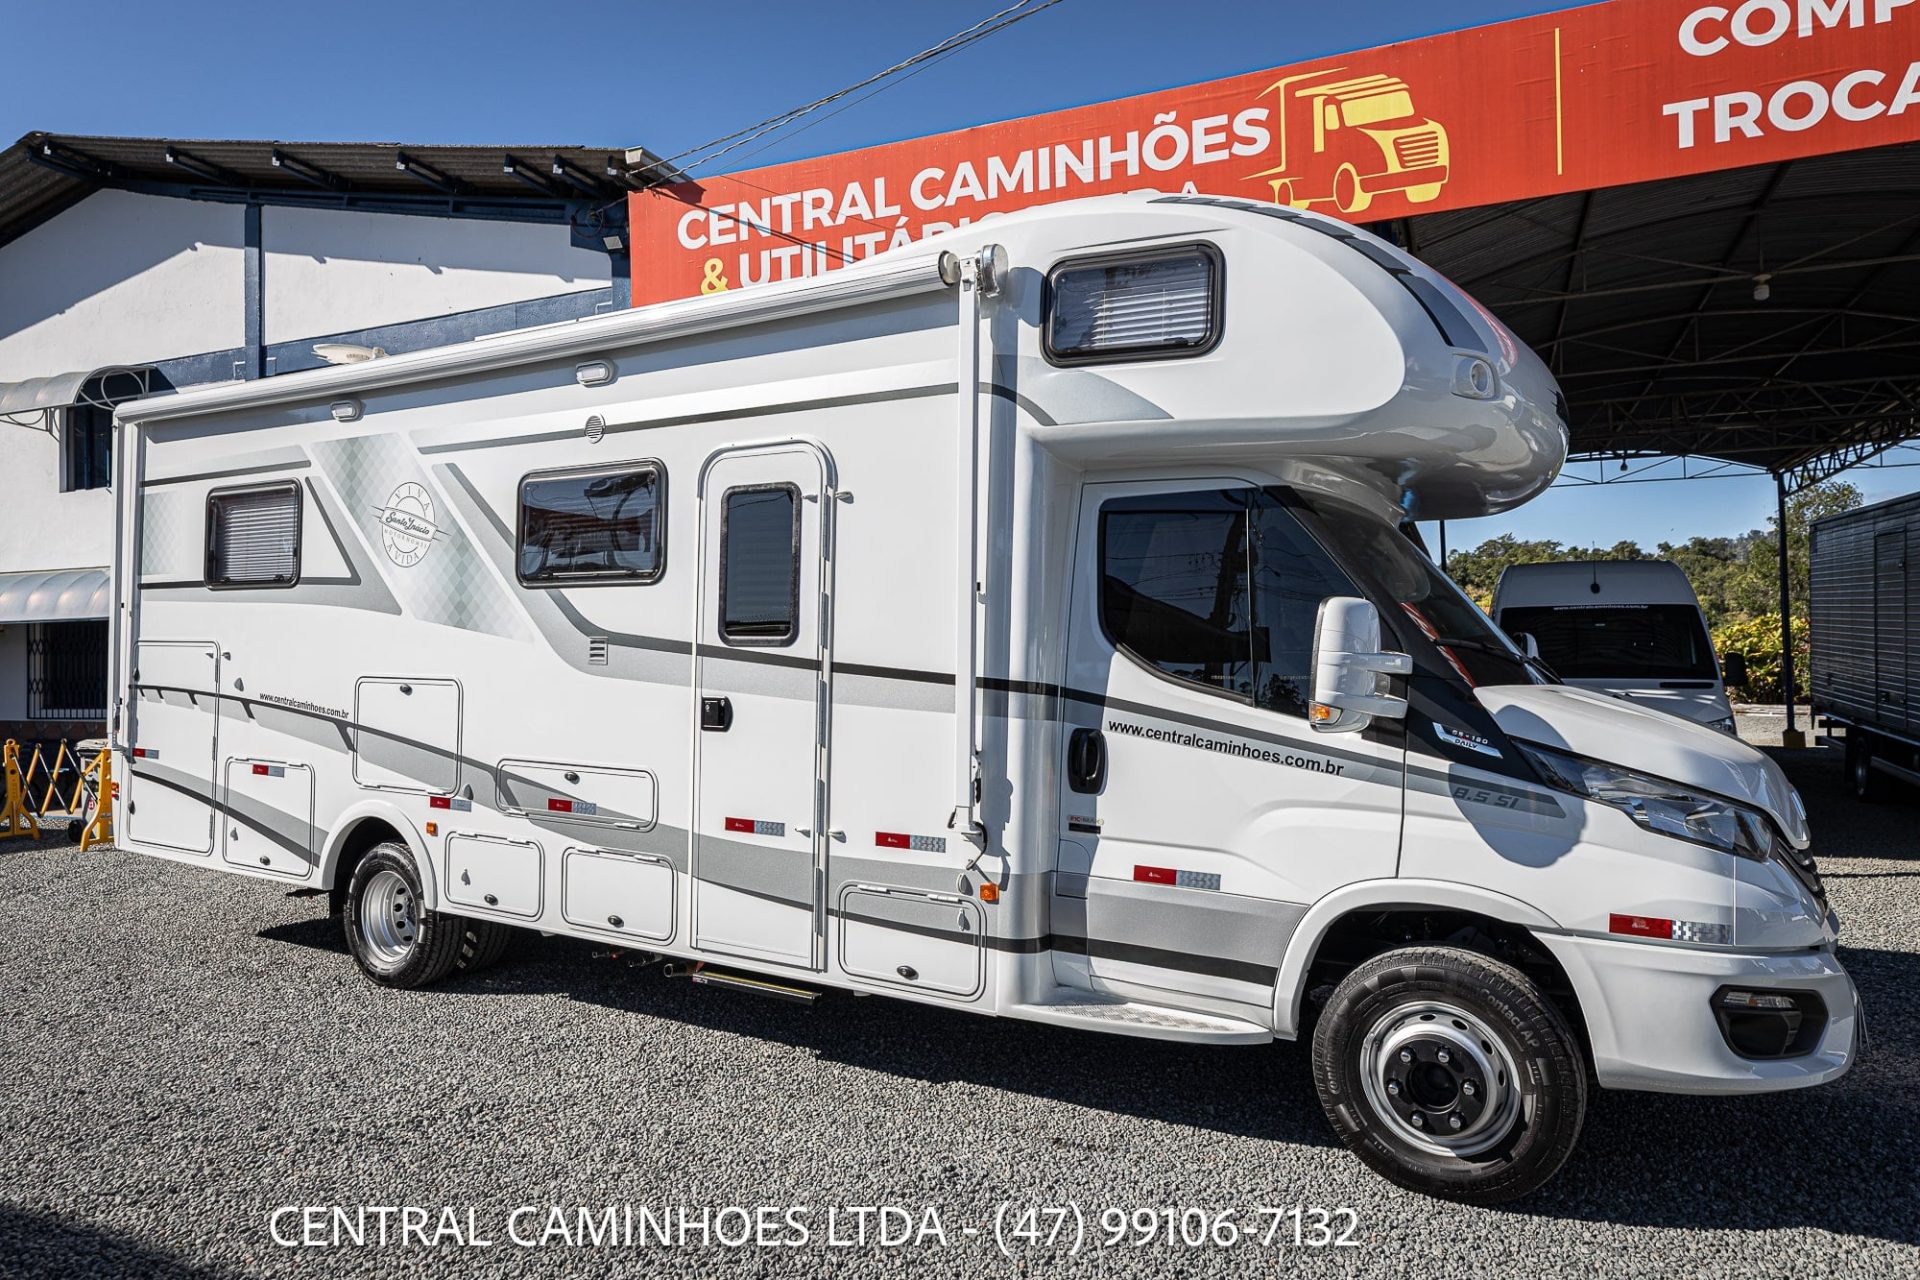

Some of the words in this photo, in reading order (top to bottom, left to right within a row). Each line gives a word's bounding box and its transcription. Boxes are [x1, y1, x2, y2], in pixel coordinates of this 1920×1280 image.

[677, 177, 901, 250] CENTRAL
[910, 110, 1271, 211] CAMINHÕES
[700, 257, 729, 295] &
[385, 511, 408, 527] Santo
[259, 693, 349, 719] www.centralcaminhoes.com.br
[1108, 719, 1344, 776] www.centralcaminhoes.com.br
[1454, 738, 1478, 750] DAILY
[1454, 786, 1491, 804] 8.5
